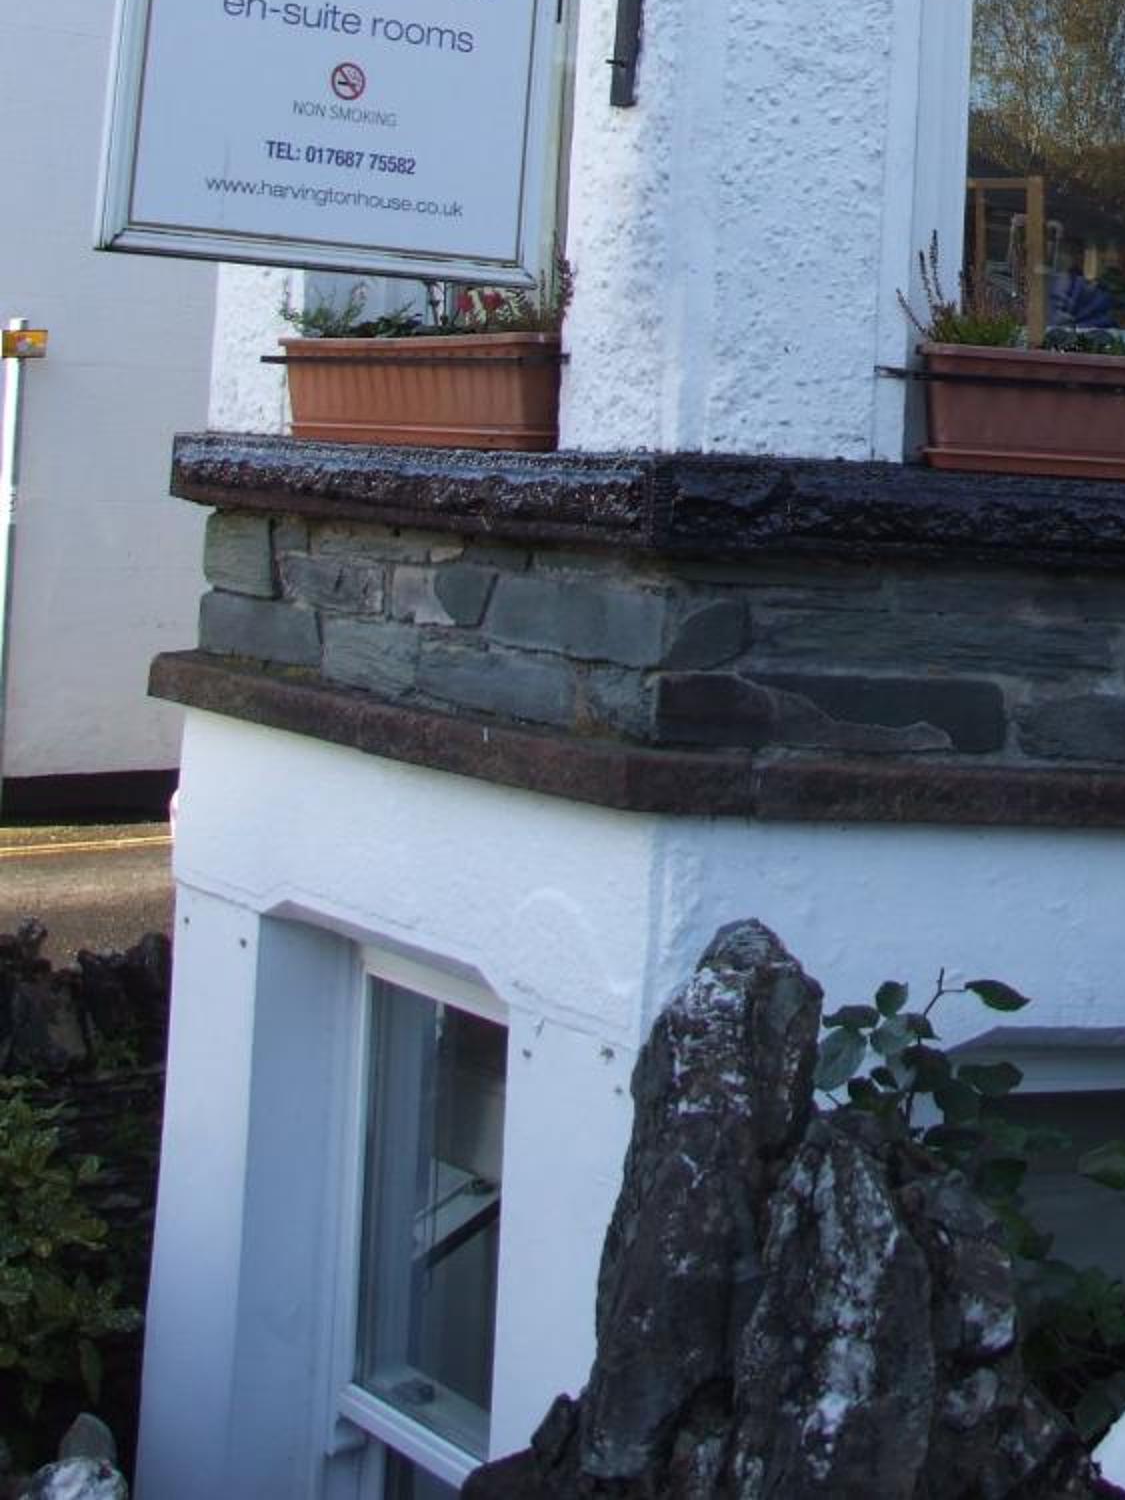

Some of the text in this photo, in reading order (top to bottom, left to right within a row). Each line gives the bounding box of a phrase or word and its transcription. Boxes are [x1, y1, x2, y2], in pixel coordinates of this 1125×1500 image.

[370, 13, 475, 54] rooms
[292, 100, 398, 127] NON SMOKING
[265, 140, 416, 176] TEL: 017687 75582
[205, 174, 464, 219] www.harvingtonhouse.co.uk
